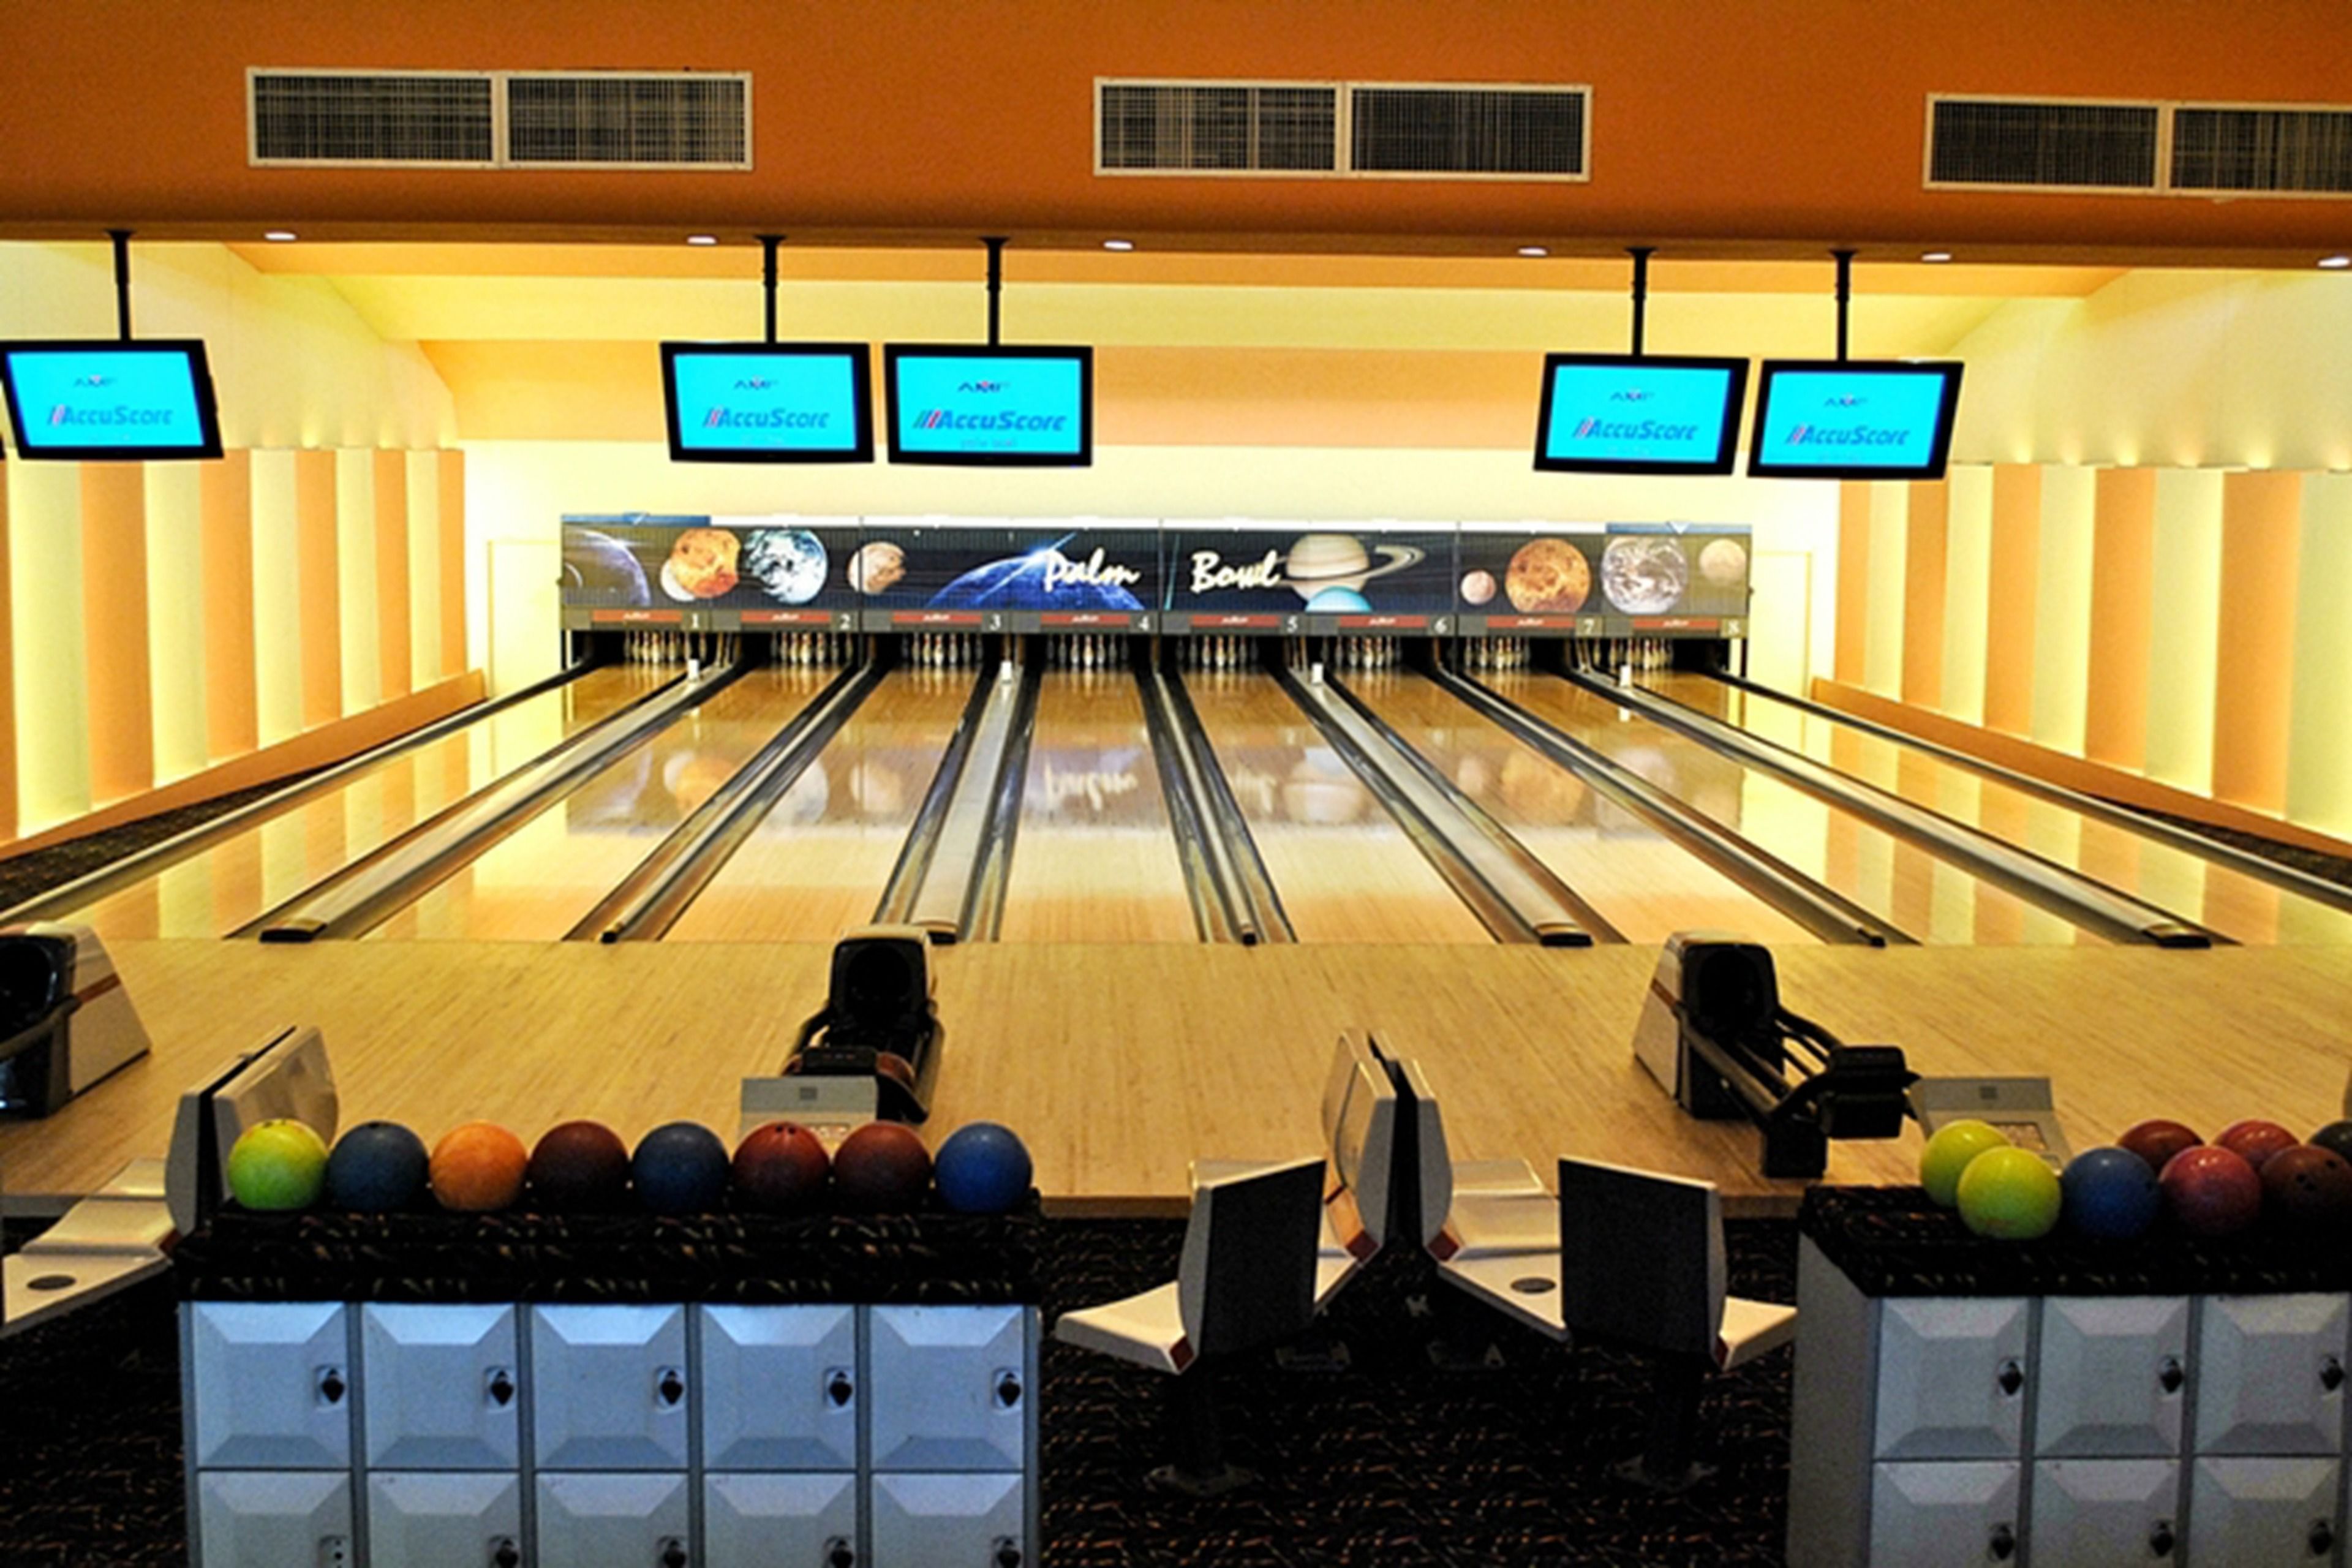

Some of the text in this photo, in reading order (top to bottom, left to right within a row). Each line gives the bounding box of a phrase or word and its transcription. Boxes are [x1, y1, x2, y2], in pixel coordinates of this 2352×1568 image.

[718, 409, 830, 429] AccuScore
[940, 410, 1066, 432] AccuScore
[1590, 418, 1698, 440] AccuScore
[1801, 425, 1910, 447] AccuScore
[1042, 547, 1281, 594] Palm Bowl
[690, 614, 699, 628] 1
[840, 614, 850, 629] 2
[990, 614, 1000, 630] 3
[1138, 615, 1149, 630] 4
[1287, 616, 1297, 631] 5
[1435, 617, 1446, 632] 6
[1584, 619, 1594, 634] 7
[1727, 619, 1739, 635] 8
